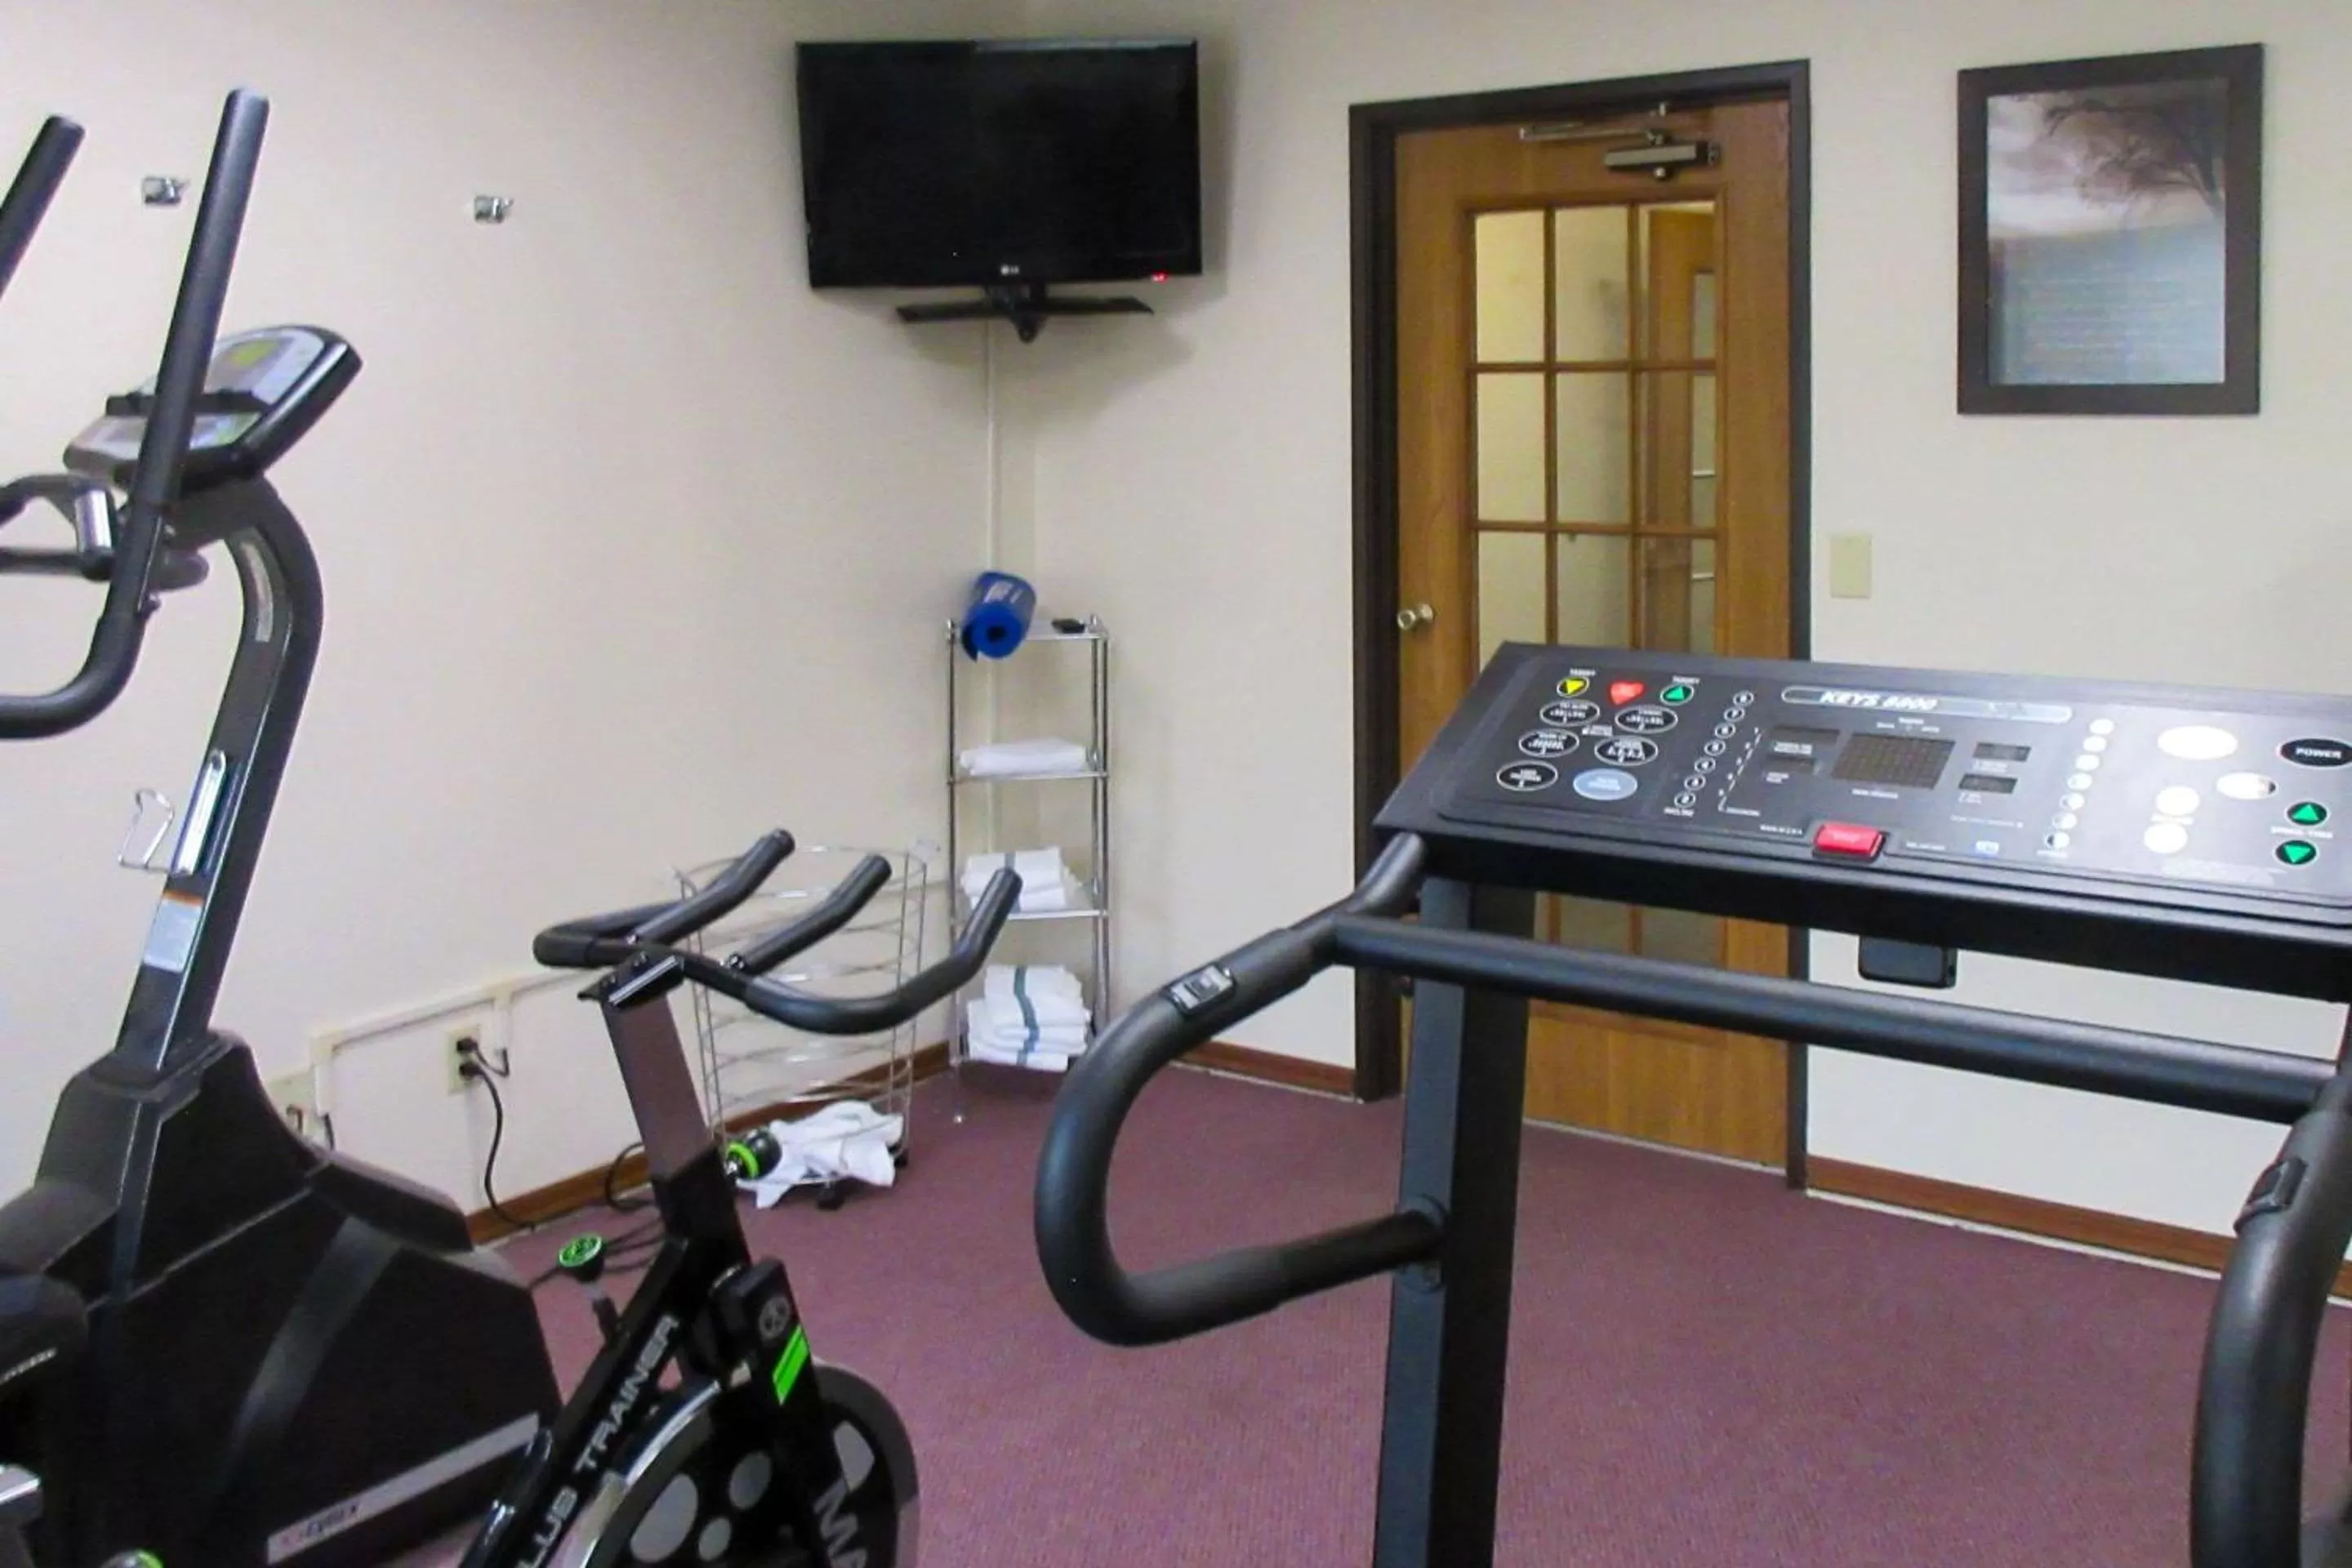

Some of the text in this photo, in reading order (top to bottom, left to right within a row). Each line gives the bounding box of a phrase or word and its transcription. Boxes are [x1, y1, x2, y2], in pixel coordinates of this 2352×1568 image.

[1820, 691, 1880, 707] KEYS
[2296, 746, 2342, 760] POWER
[573, 1314, 679, 1472] TRAINER
